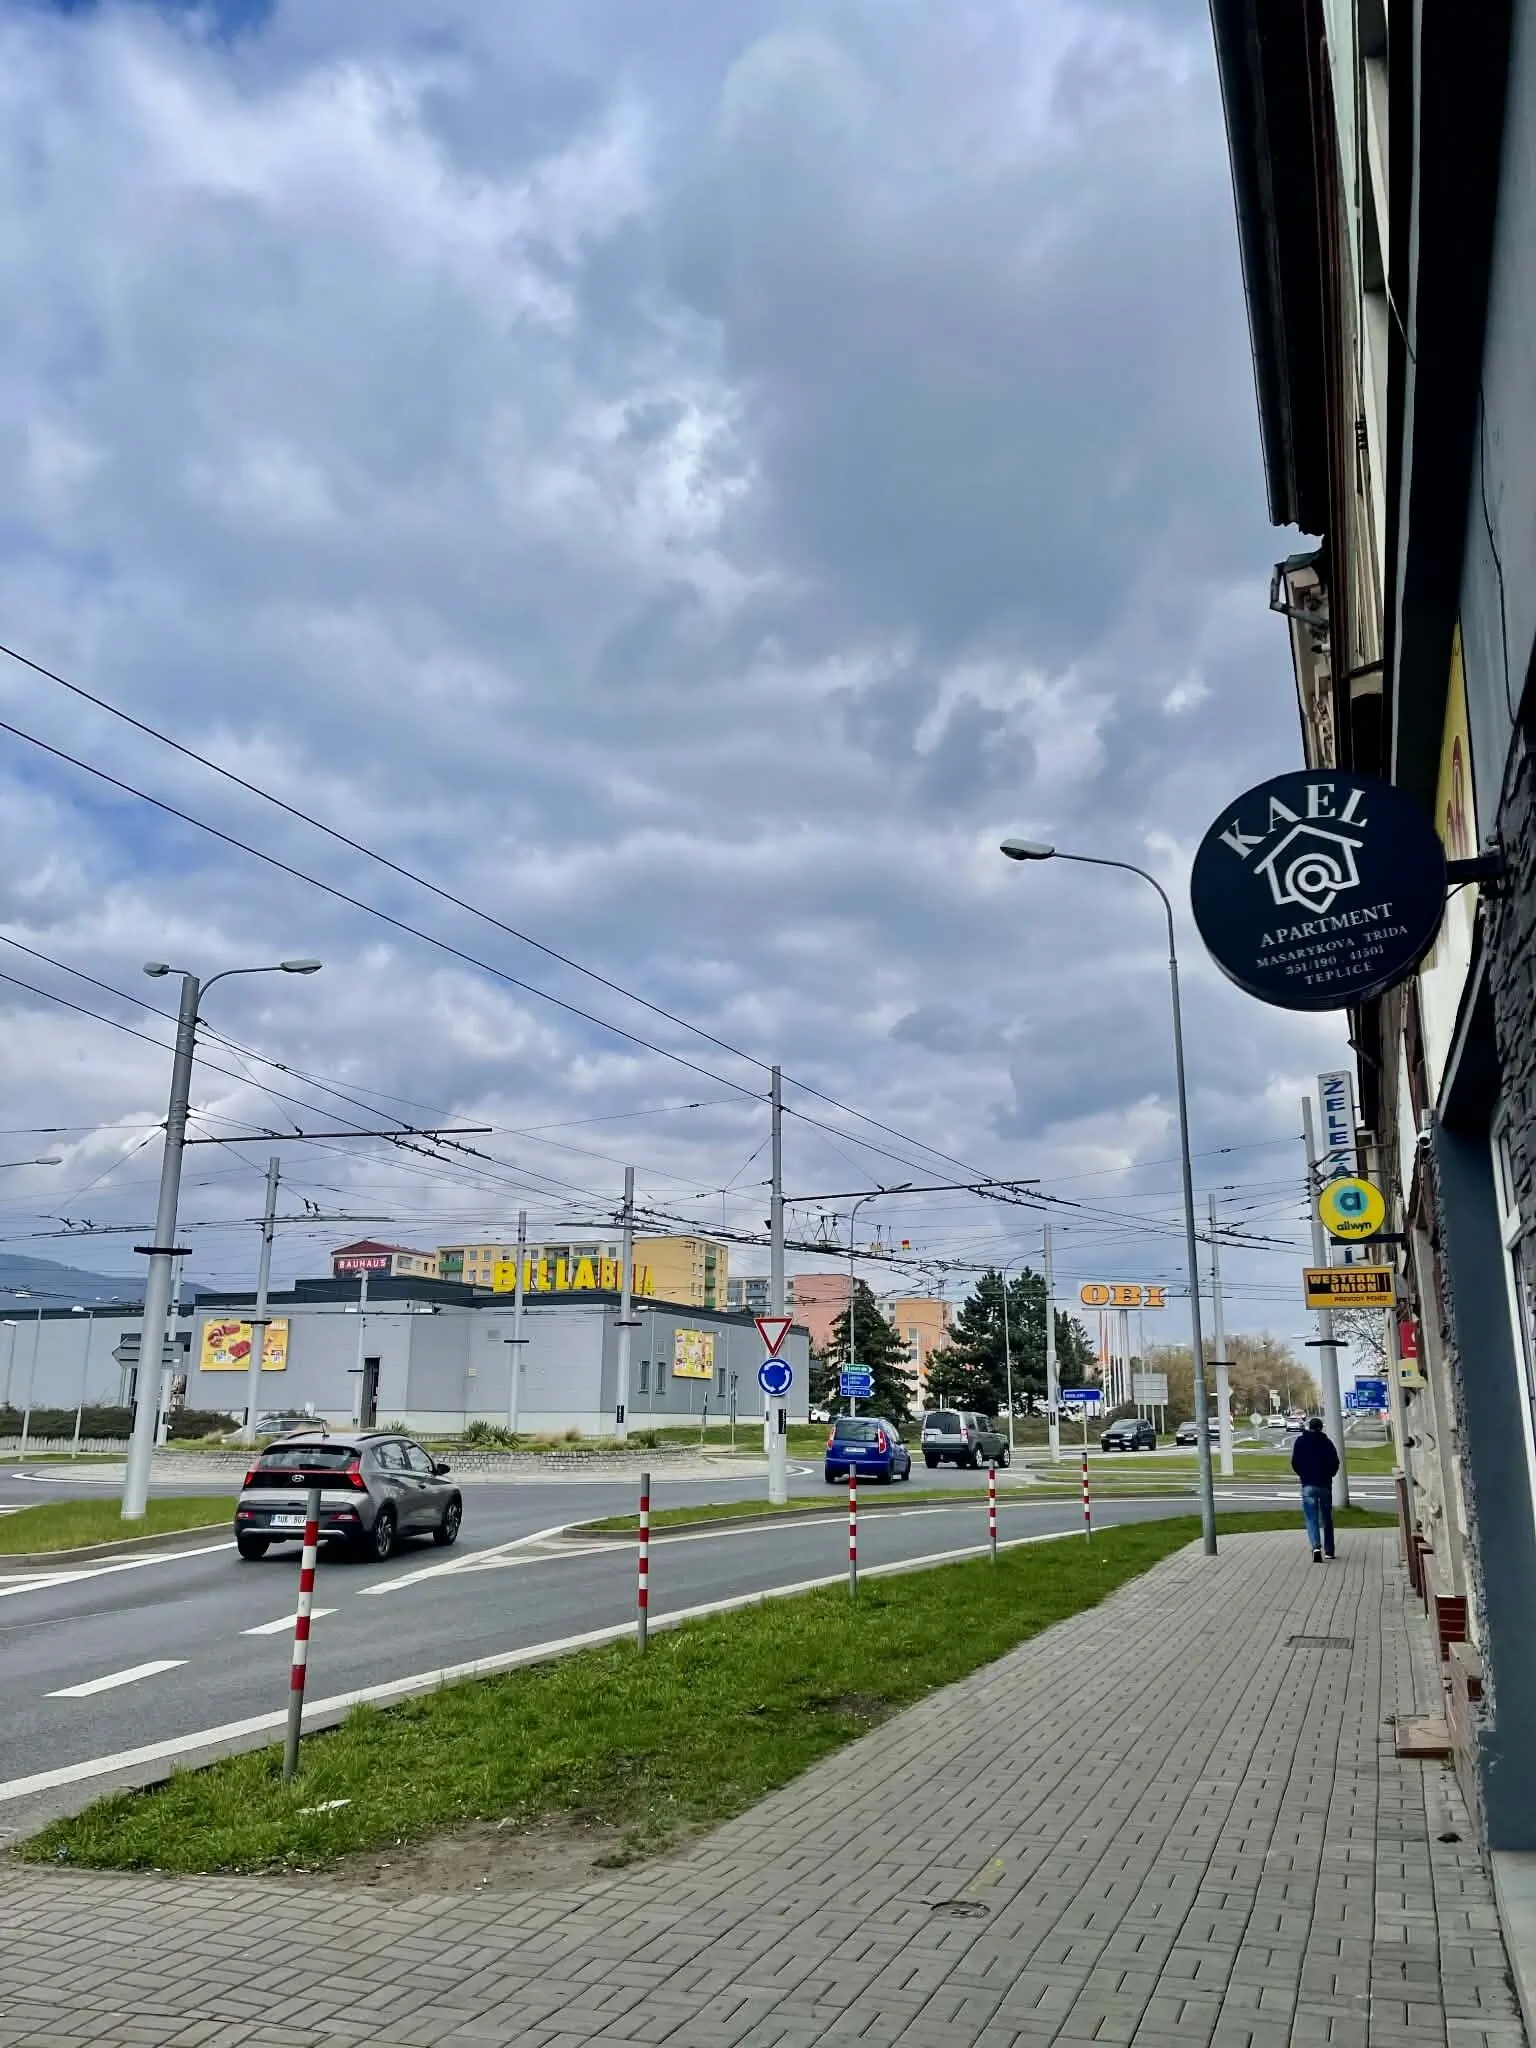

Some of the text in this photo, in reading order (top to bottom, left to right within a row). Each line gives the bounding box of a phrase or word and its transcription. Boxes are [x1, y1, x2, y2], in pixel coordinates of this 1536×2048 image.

[1218, 784, 1368, 860] KAEL
[1260, 902, 1393, 948] APARTMENT
[1256, 937, 1355, 968] MASARYKOVA
[1304, 961, 1375, 985] TEPLICE
[1336, 1221, 1372, 1232] allwyn
[339, 1258, 386, 1269] BAUHAUS
[493, 1256, 598, 1294] BILLA
[1309, 1273, 1376, 1284] WESTERN
[1331, 1283, 1377, 1292] UNION
[1081, 1284, 1165, 1306] OBI
